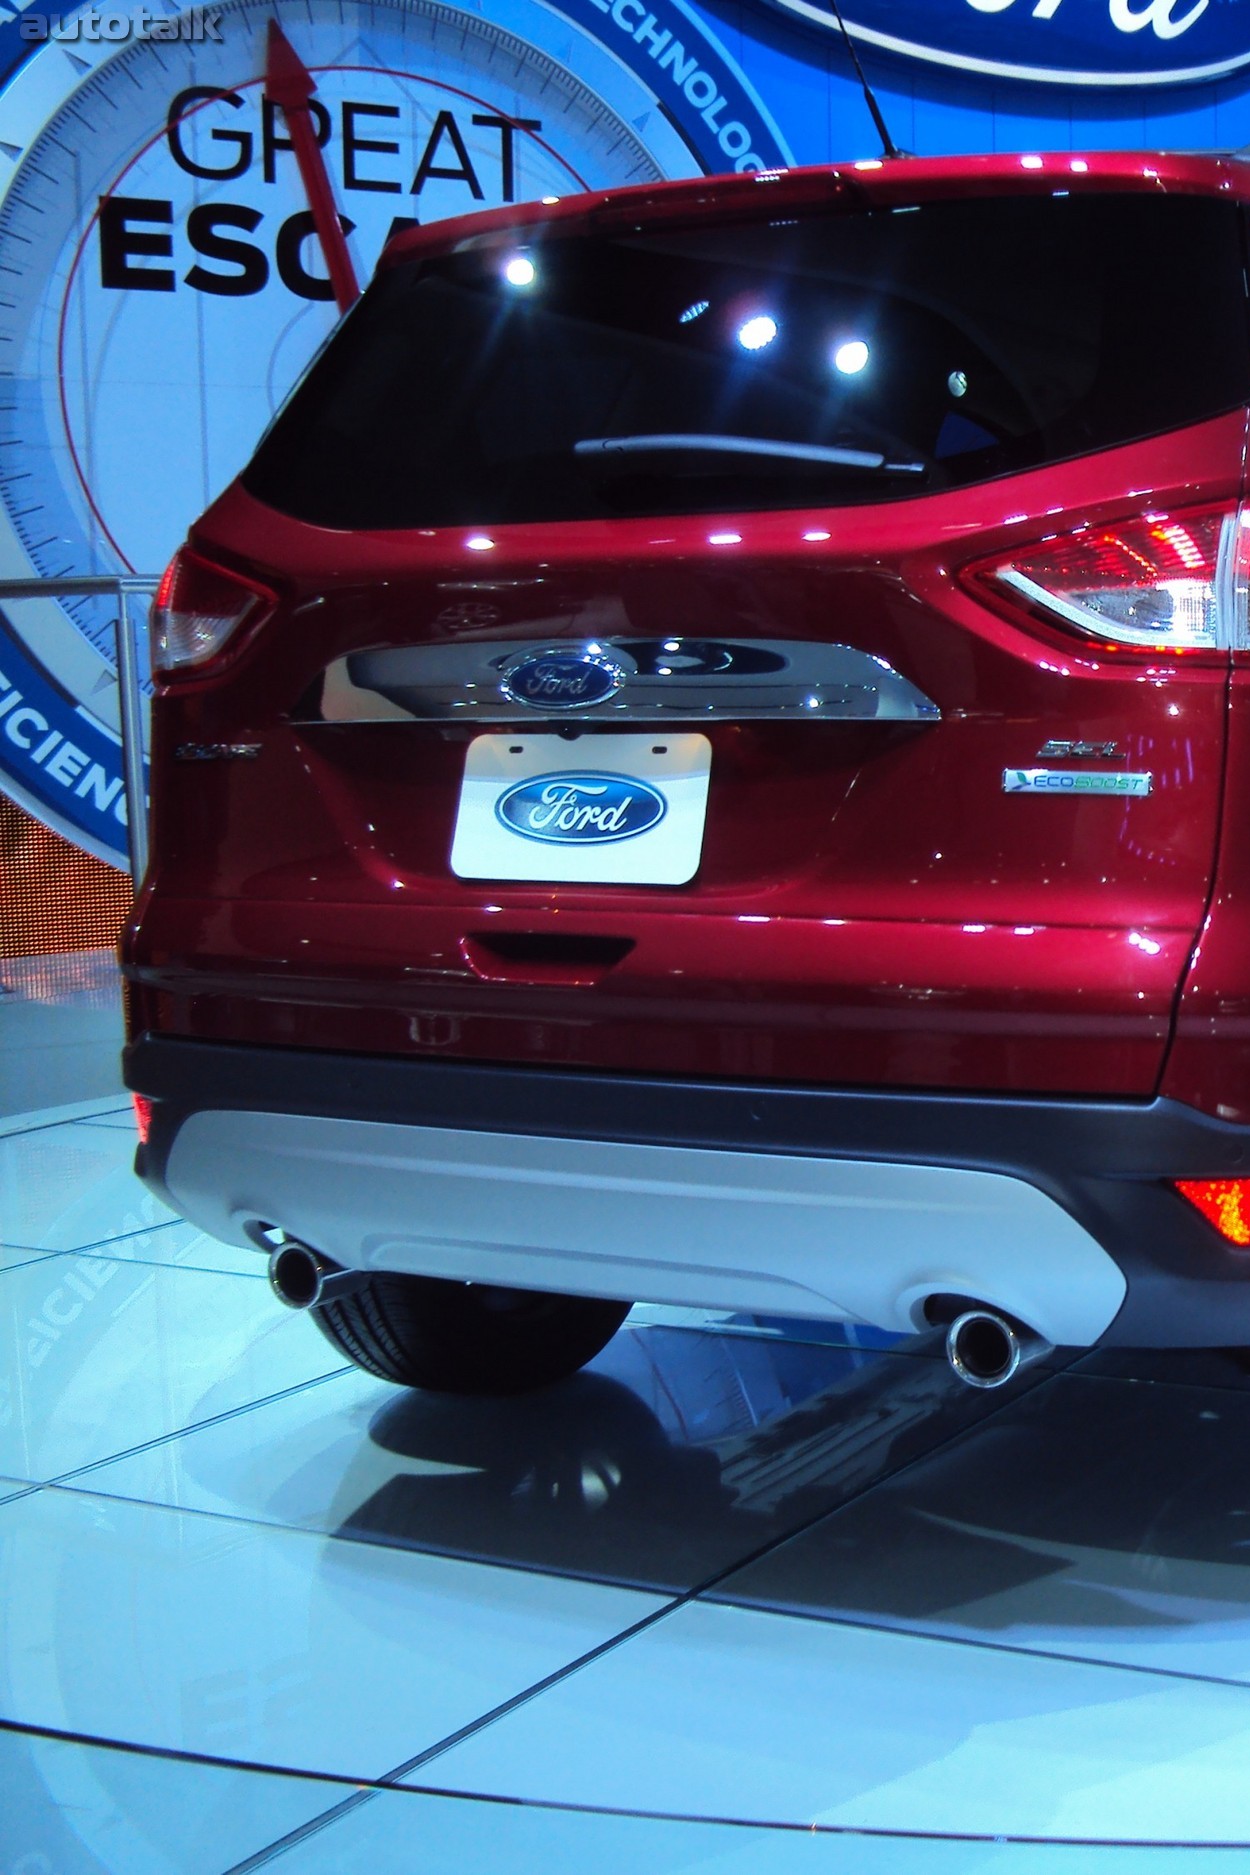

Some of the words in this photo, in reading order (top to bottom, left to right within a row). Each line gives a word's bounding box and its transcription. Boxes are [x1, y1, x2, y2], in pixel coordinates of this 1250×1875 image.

[166, 86, 542, 202] GREAT
[99, 196, 421, 301] ESC
[527, 663, 593, 695] Ford
[0, 669, 128, 826] ICIEN
[528, 783, 633, 831] Ford
